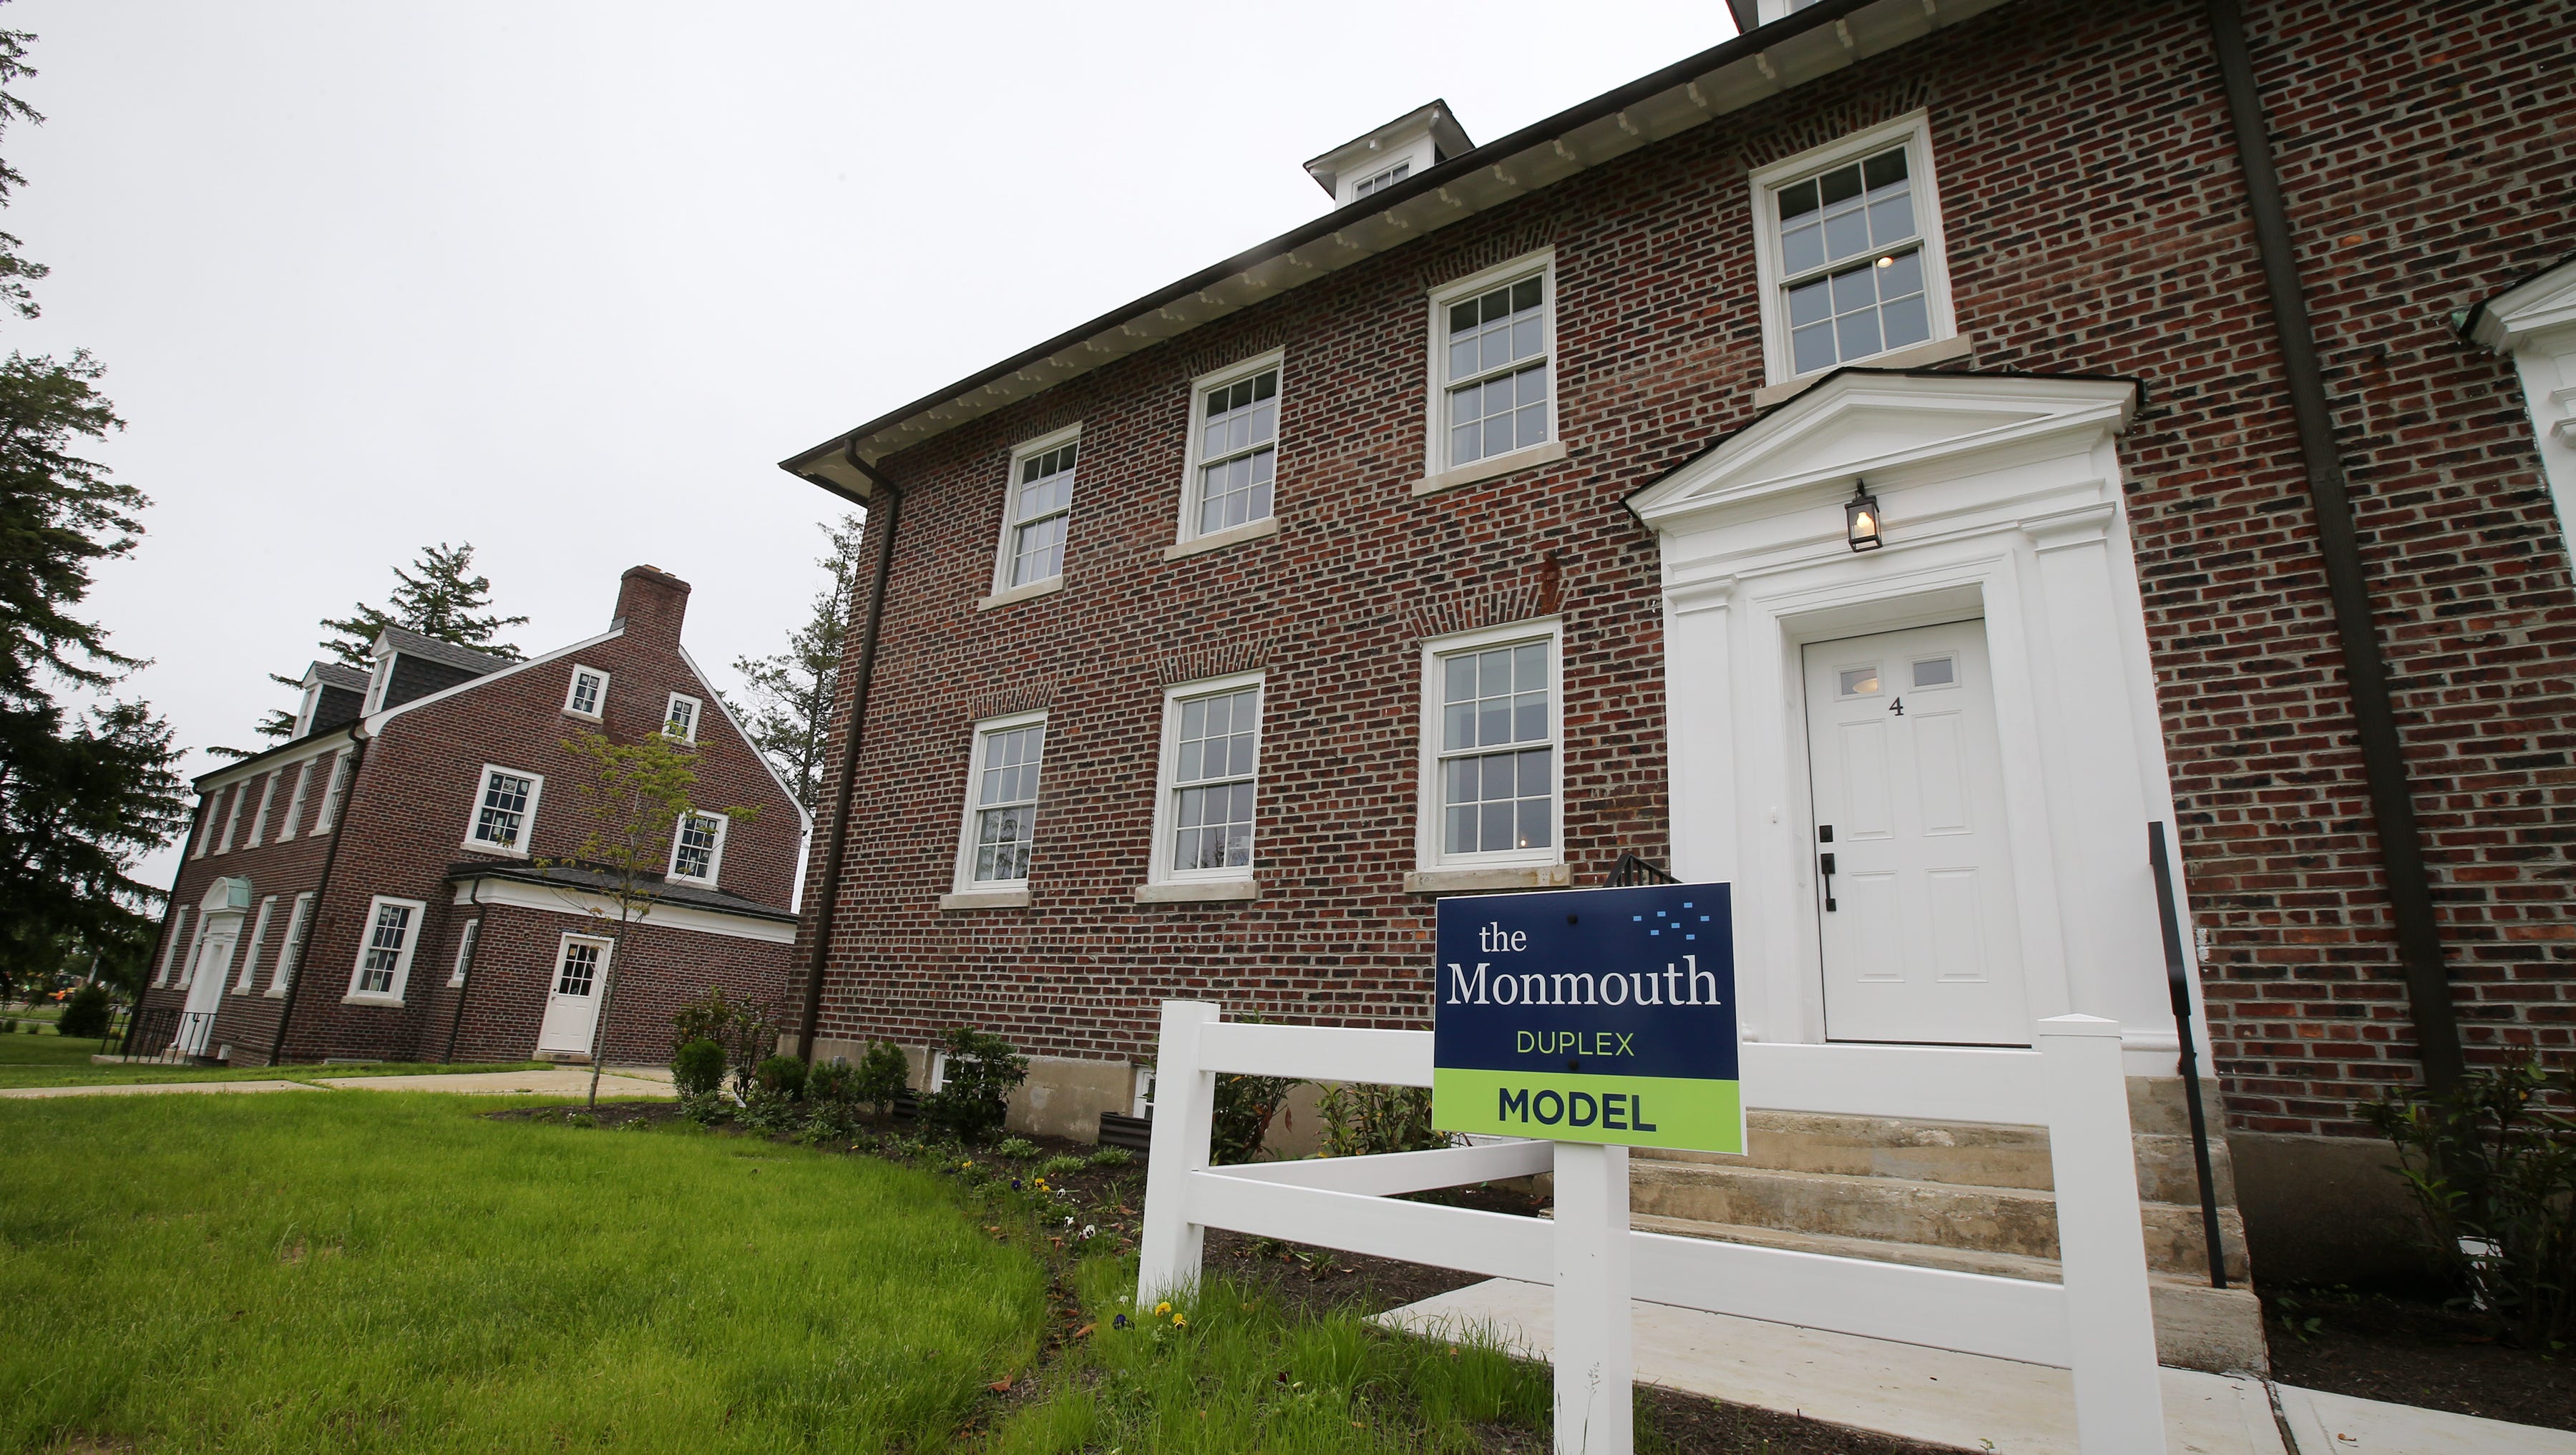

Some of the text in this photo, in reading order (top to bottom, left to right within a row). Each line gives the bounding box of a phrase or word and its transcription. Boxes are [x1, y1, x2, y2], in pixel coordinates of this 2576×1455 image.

[1889, 697, 1904, 716] 4
[1479, 921, 1527, 952] the
[1446, 954, 1721, 1006] Monmouth
[1517, 1031, 1634, 1057] DUPLEX
[1499, 1087, 1657, 1132] MODEL
